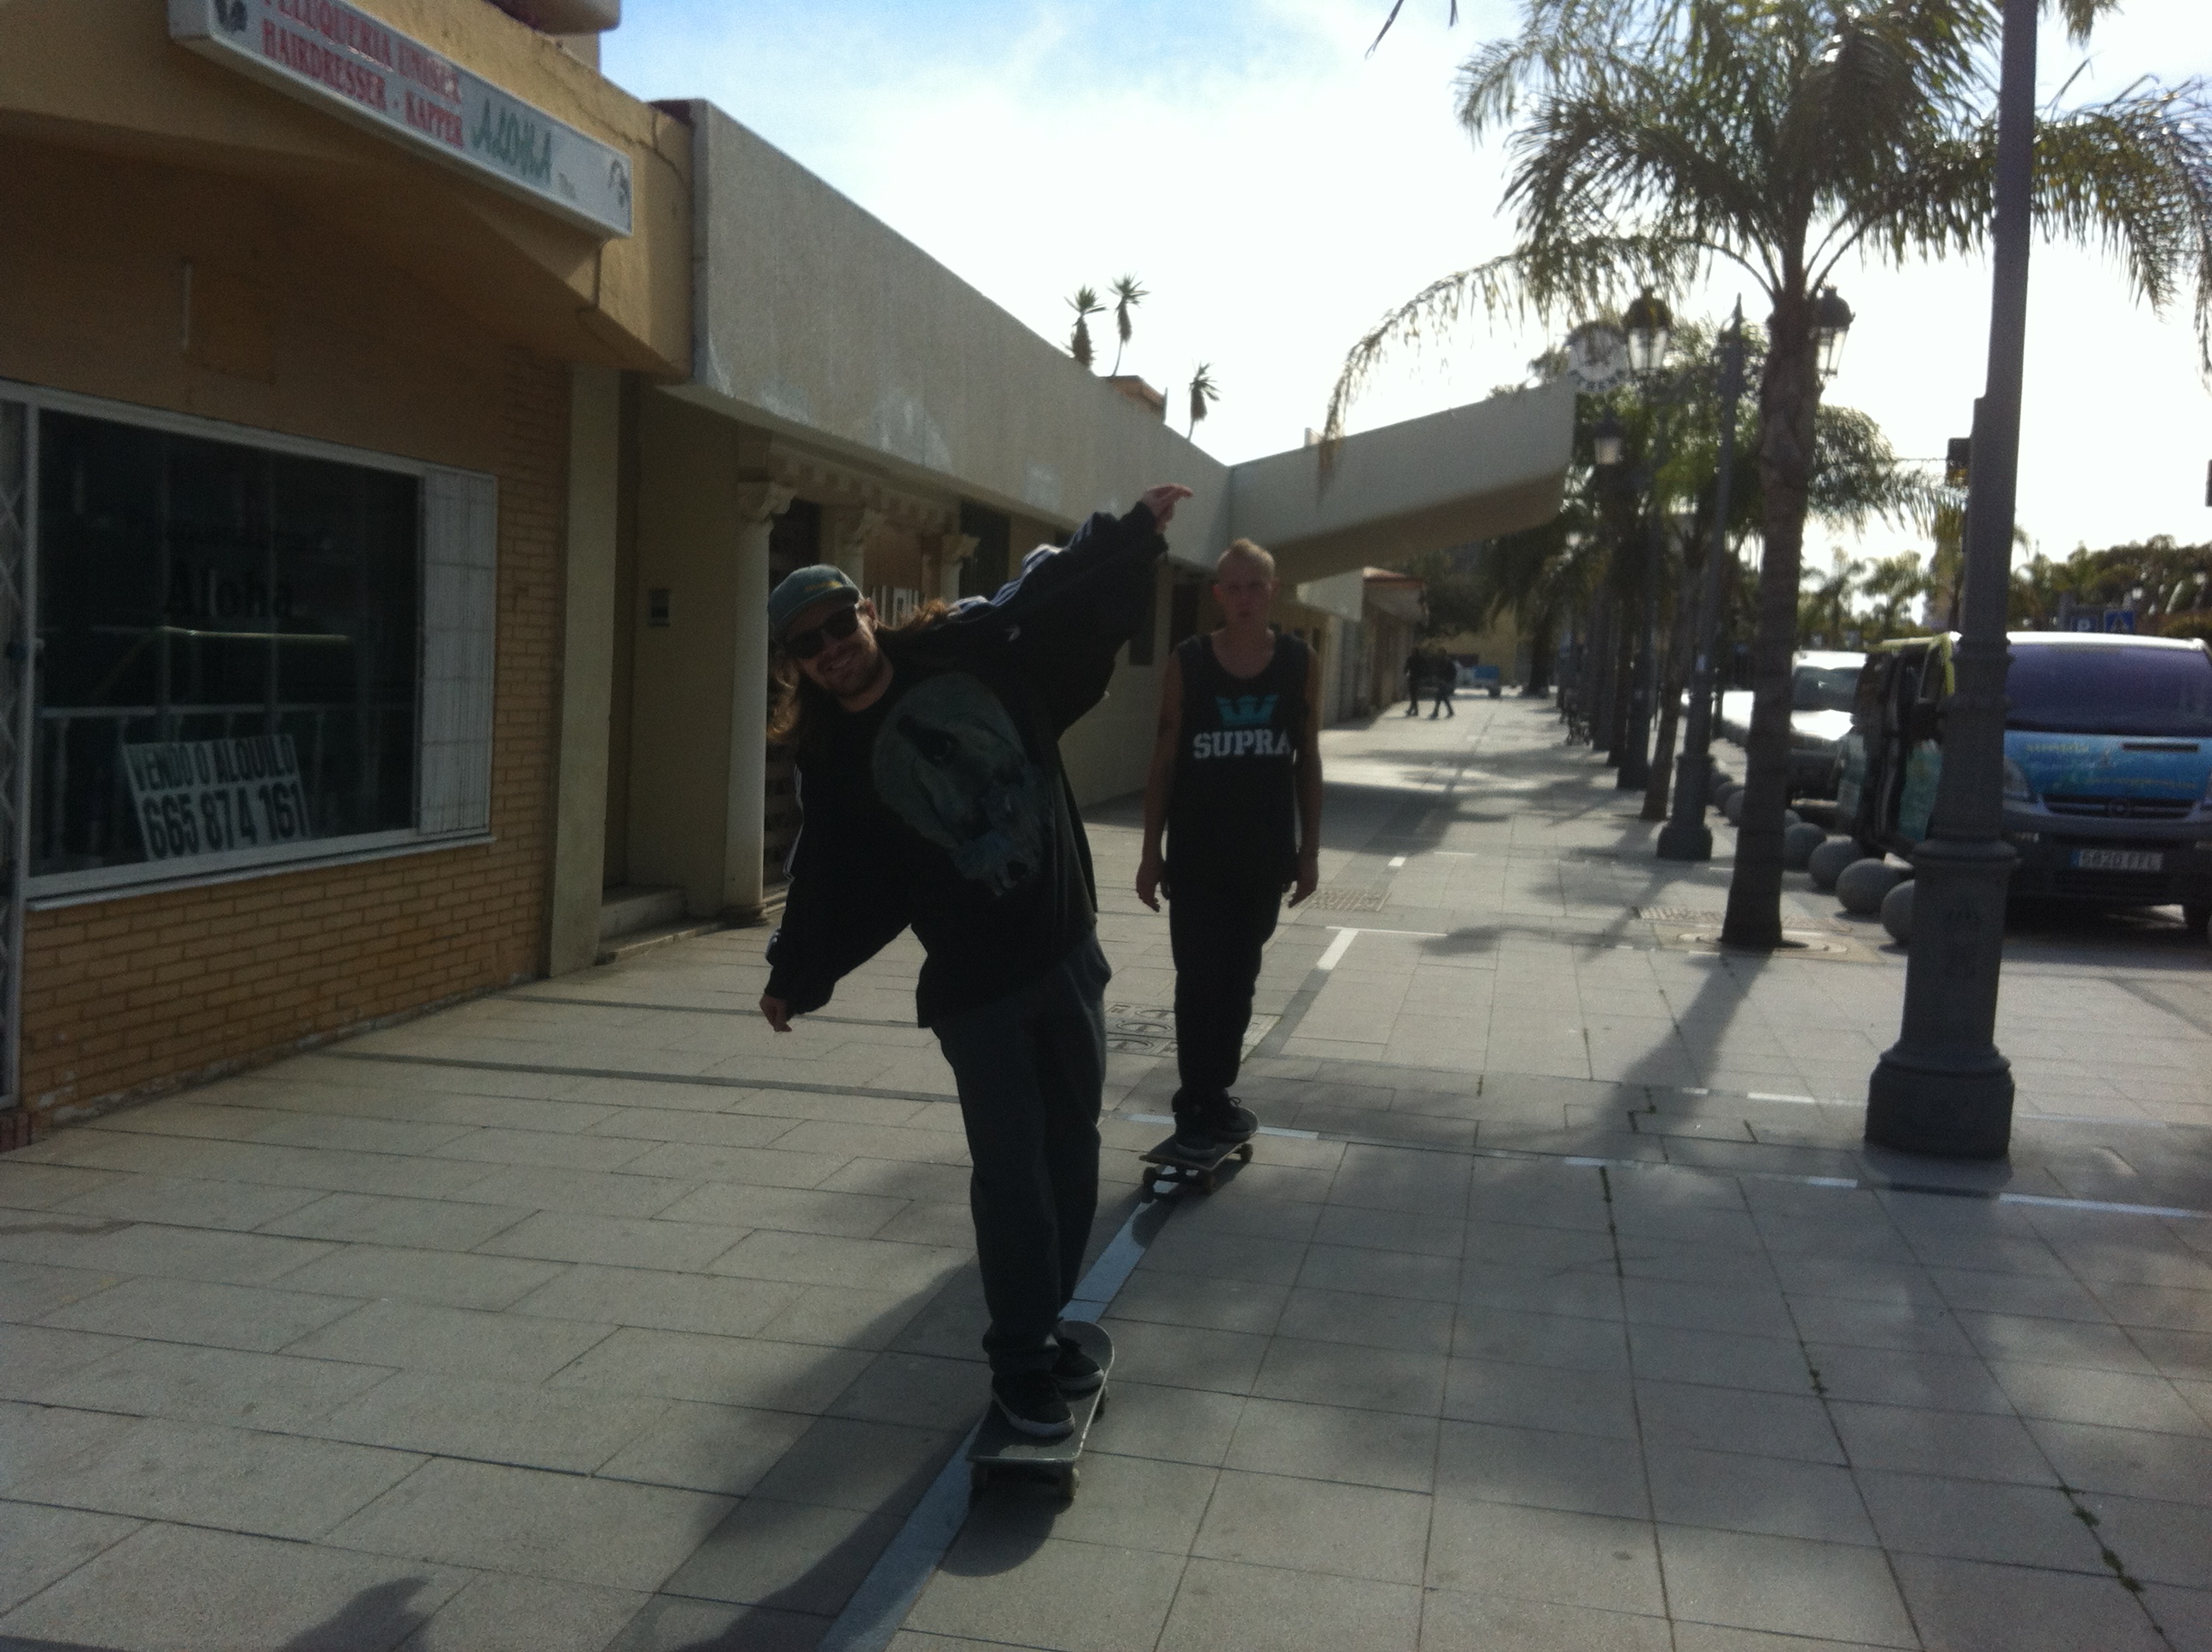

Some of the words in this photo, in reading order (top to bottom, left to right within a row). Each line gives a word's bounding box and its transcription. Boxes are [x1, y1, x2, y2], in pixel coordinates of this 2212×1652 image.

[128, 742, 195, 791] VENDO
[212, 736, 295, 784] ALQUILO
[1193, 729, 1291, 759] SUPRA
[143, 793, 200, 858] 665
[200, 786, 258, 850] 874
[259, 781, 307, 841] 161
